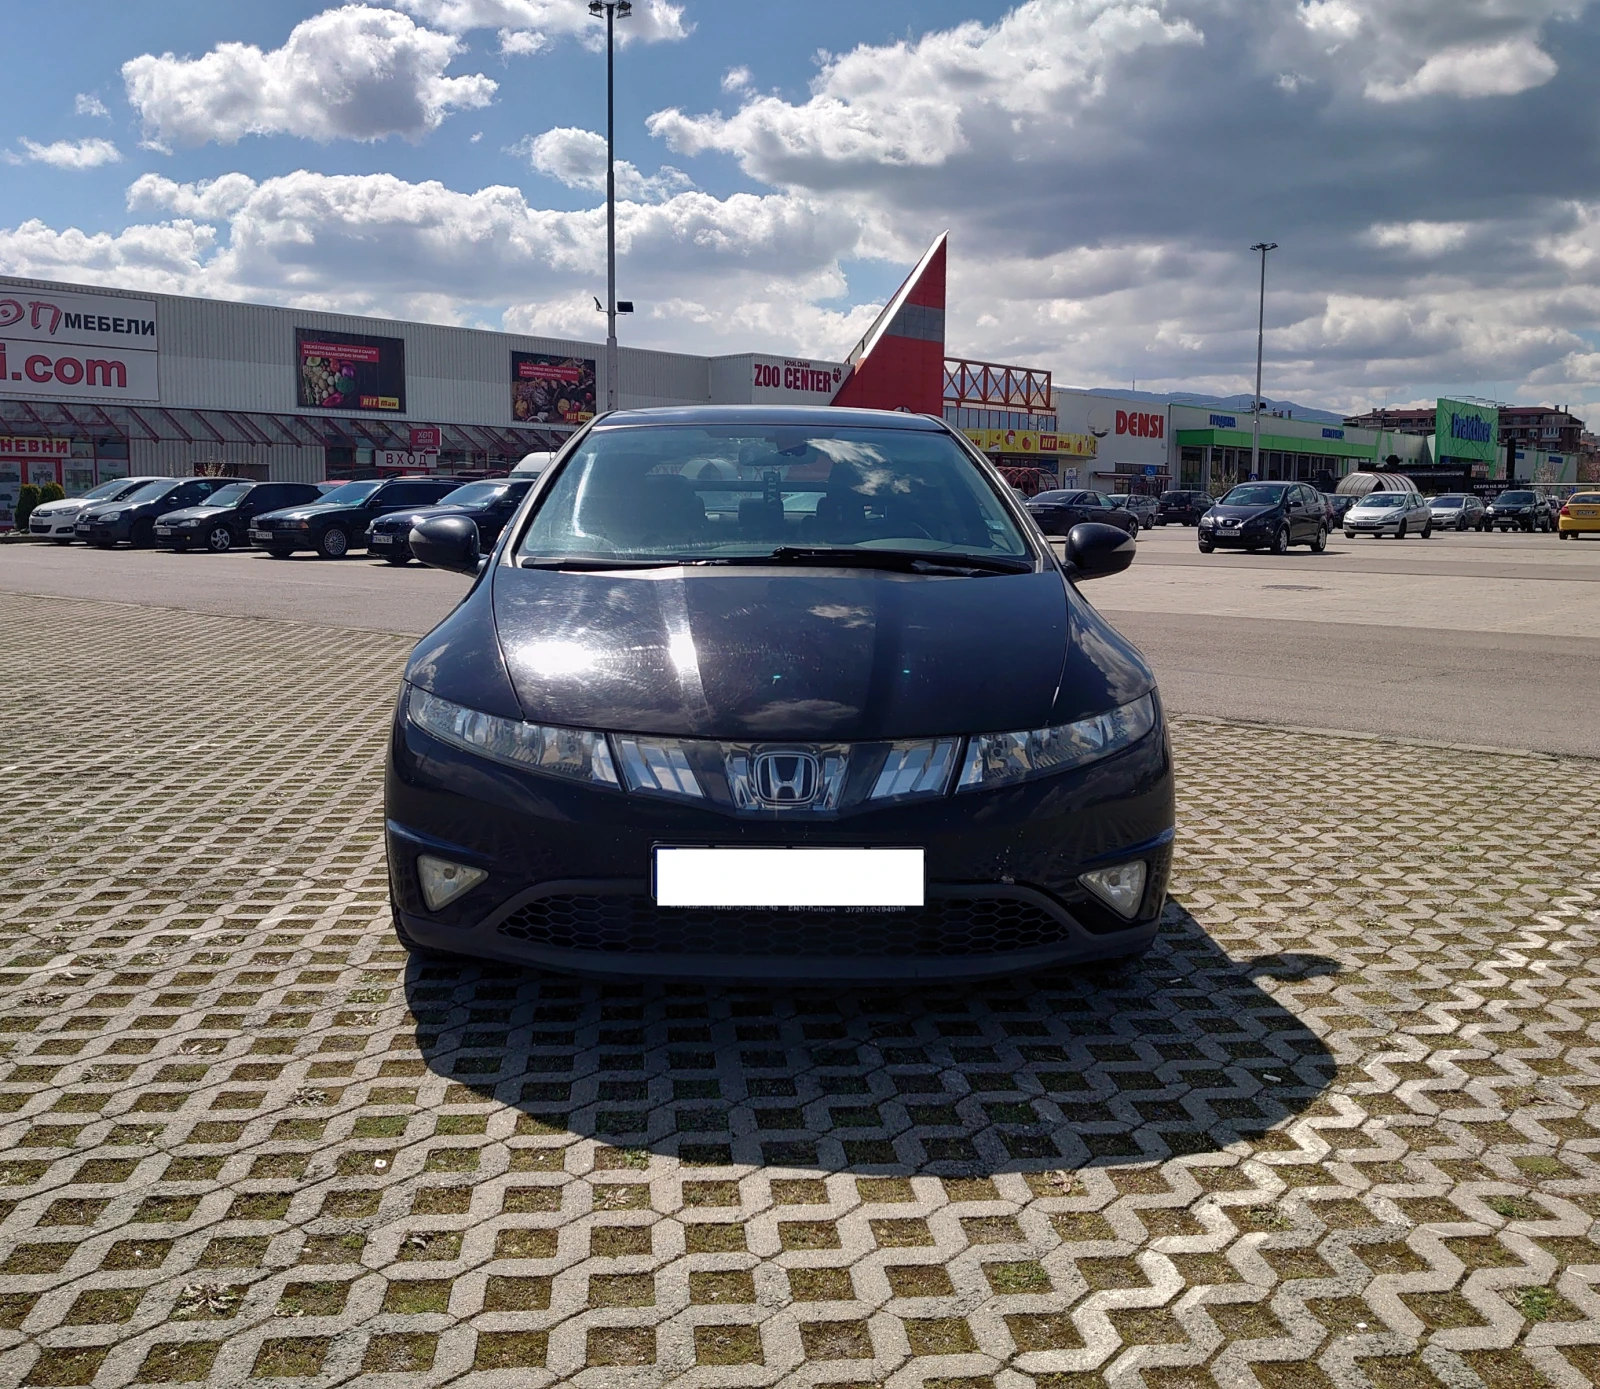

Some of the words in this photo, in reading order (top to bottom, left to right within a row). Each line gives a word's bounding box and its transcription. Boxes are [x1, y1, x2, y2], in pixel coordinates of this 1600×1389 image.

[64, 312, 155, 336] МЕБЕЛИ
[754, 363, 780, 388] ZOO
[784, 367, 831, 393] CENTER
[363, 397, 377, 406] HIT
[1116, 410, 1164, 438] DENSI
[1451, 412, 1492, 442] Praktiker
[1042, 438, 1056, 448] HIT
[386, 453, 427, 467] ВХОД
